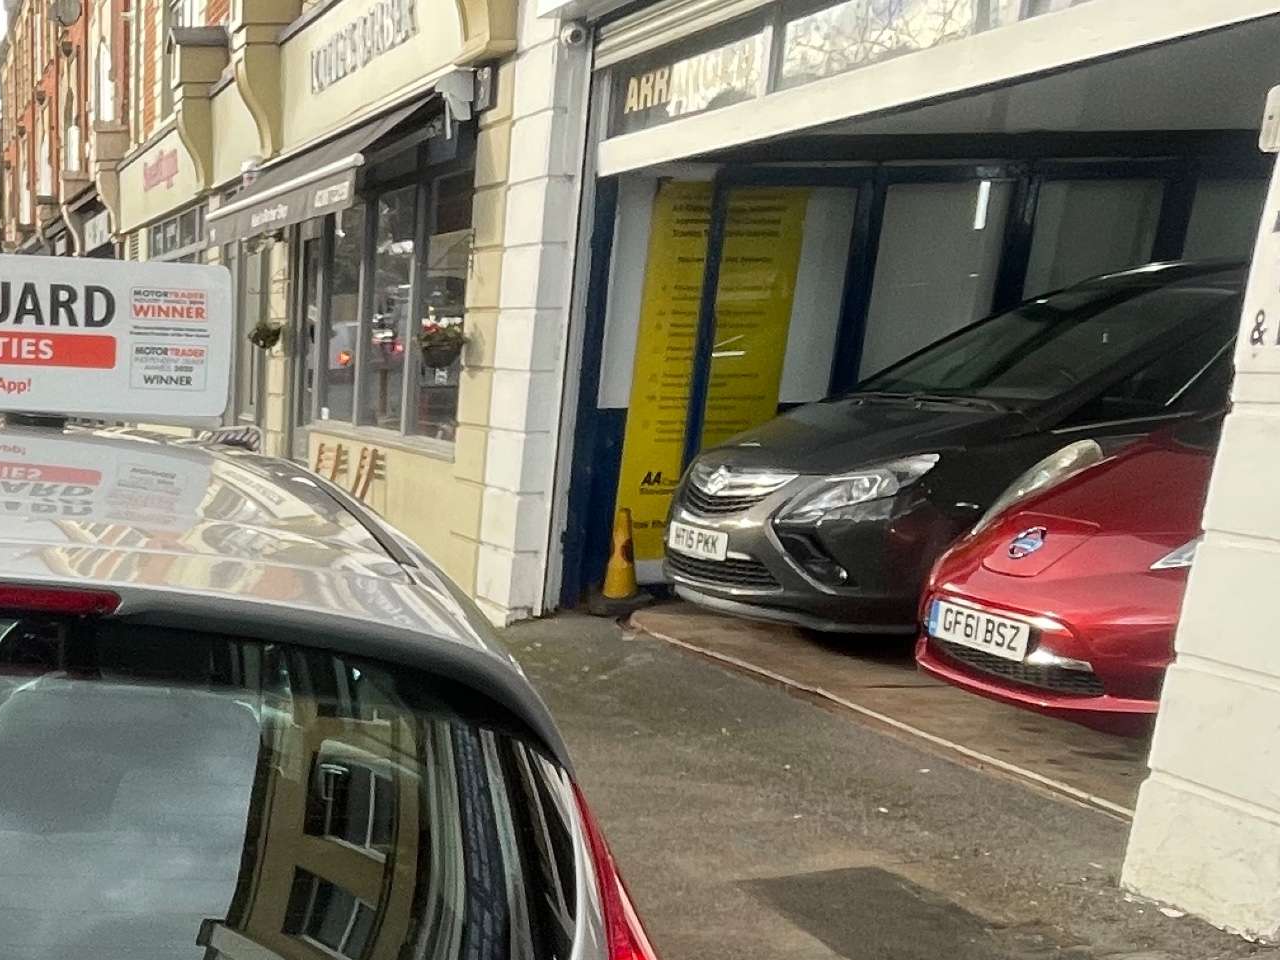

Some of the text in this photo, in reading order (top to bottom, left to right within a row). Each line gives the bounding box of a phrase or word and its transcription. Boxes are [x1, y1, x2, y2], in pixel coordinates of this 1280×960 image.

[133, 304, 206, 319] WINNER
[1250, 309, 1267, 346] &
[143, 375, 193, 386] WINNER
[640, 472, 662, 485] AA
[696, 532, 719, 553] PKK
[943, 608, 1020, 652] GF61 BSZ
